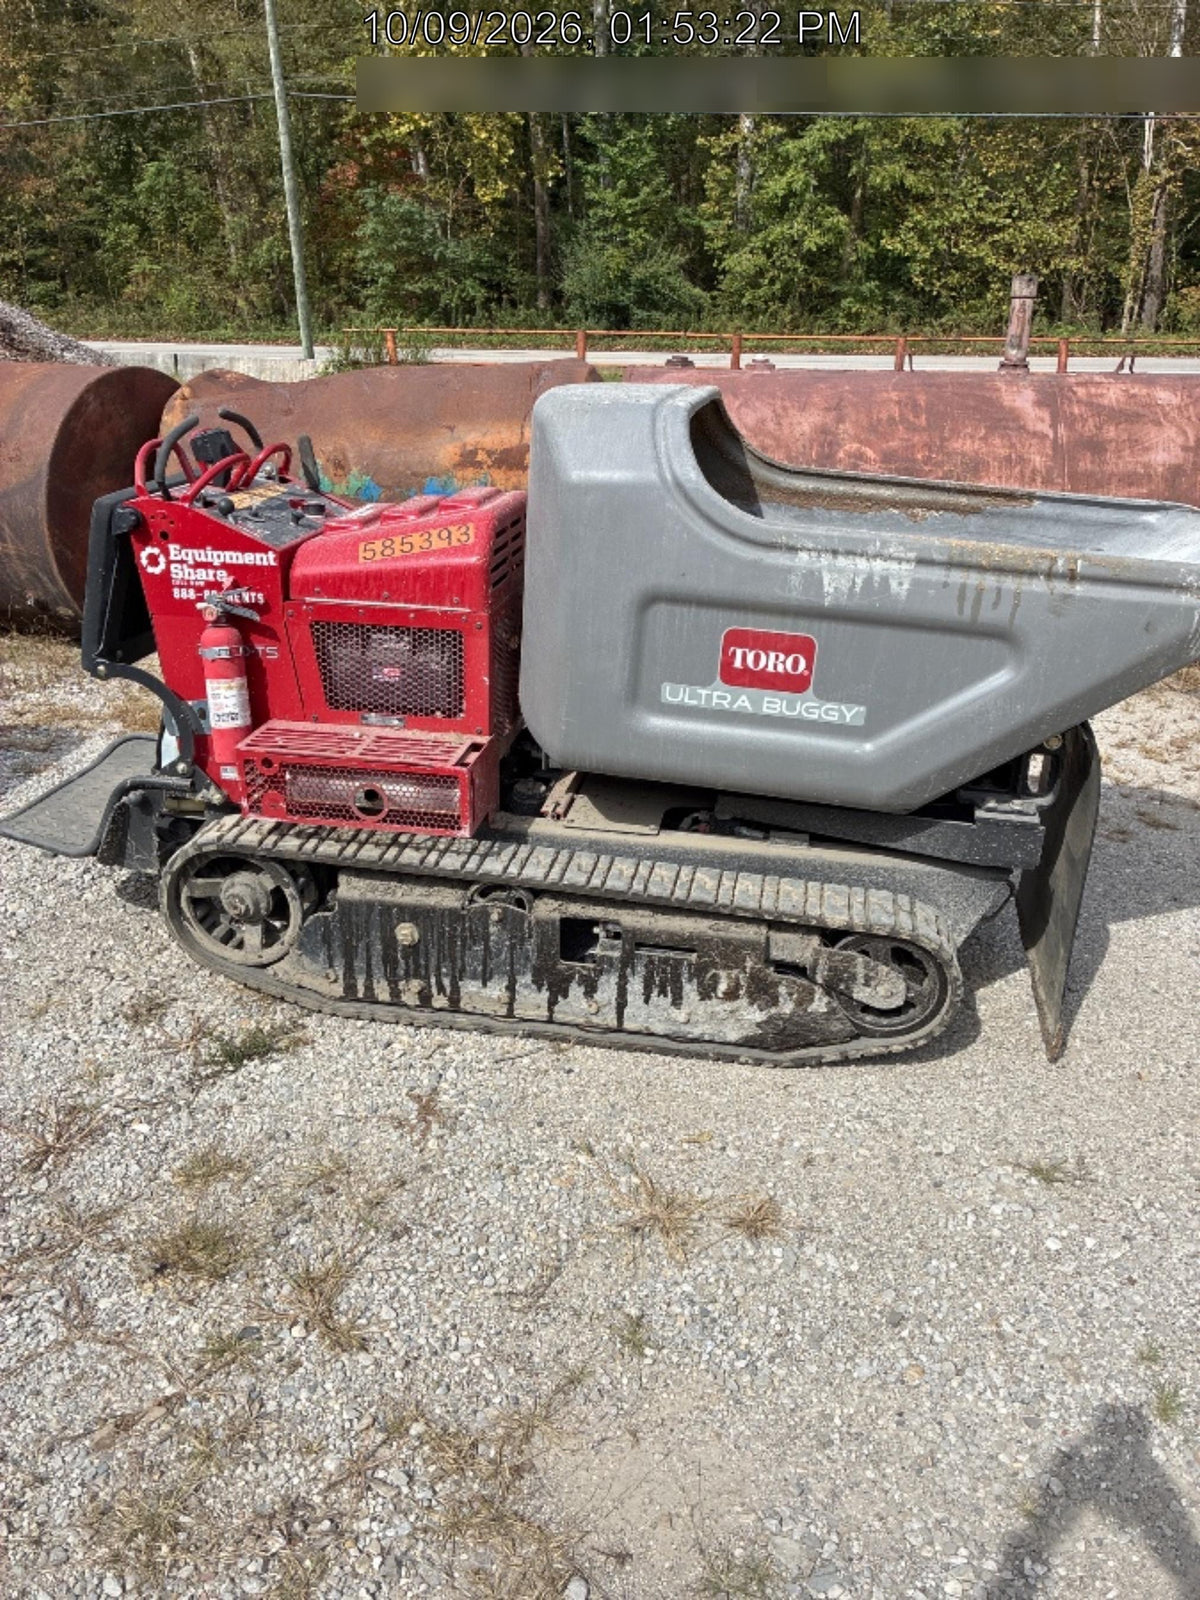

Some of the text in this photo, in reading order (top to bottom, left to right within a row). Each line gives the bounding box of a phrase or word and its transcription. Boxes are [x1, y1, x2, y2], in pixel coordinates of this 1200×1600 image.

[168, 544, 277, 566] Equipment
[362, 525, 470, 560] 585393
[170, 564, 228, 582] Share
[729, 646, 807, 675] TORO
[665, 686, 860, 722] ULTRA BUGGY
